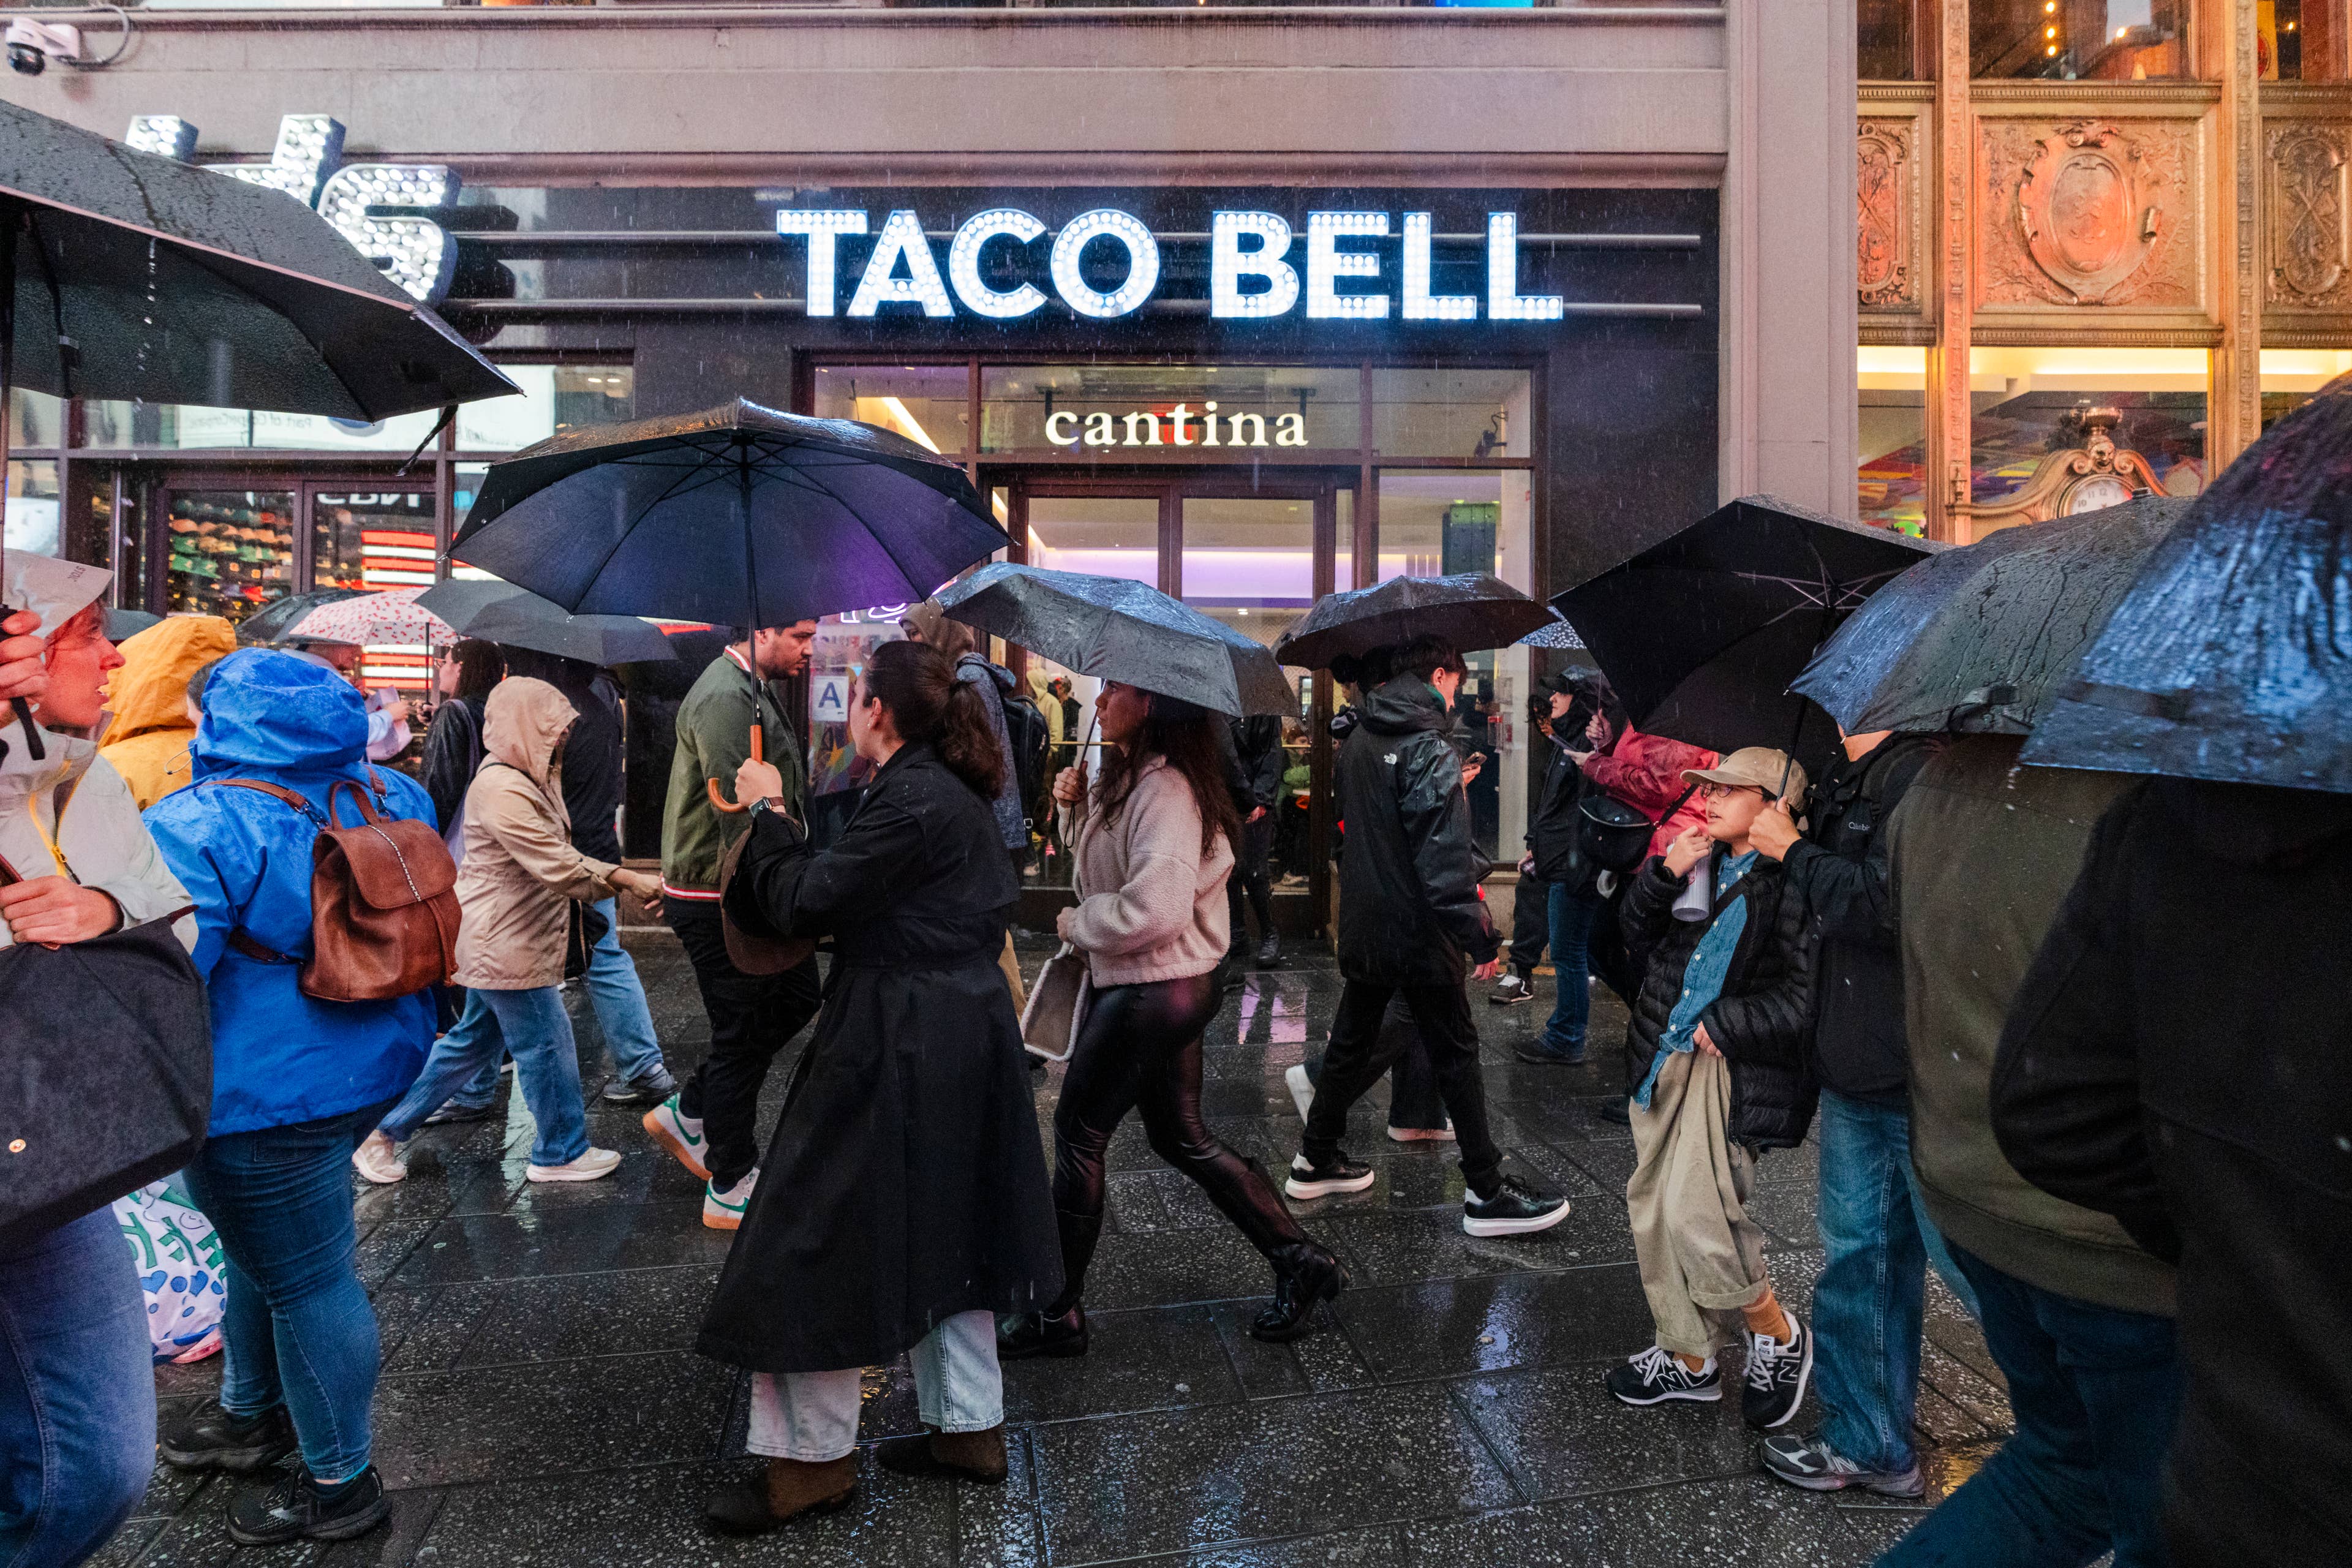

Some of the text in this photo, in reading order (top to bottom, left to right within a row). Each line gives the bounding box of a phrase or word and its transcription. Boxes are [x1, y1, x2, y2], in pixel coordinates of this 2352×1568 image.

[776, 207, 1564, 320] TACO BELL
[1044, 400, 1309, 447] cantina
[818, 681, 842, 708] A
[1656, 1370, 1687, 1393] N
